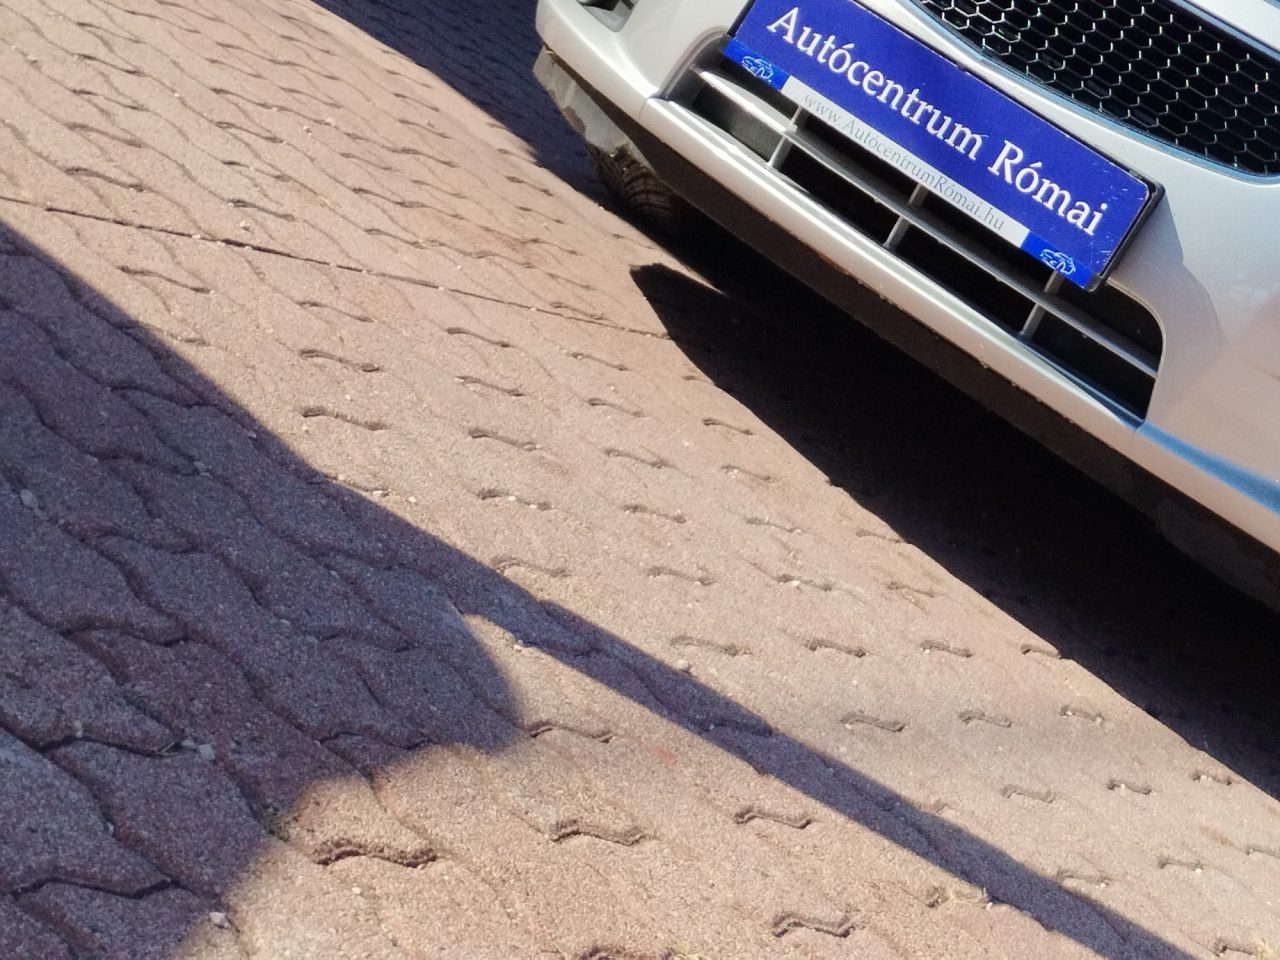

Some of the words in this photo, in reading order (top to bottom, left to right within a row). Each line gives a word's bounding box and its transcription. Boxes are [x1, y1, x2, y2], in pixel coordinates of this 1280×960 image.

[766, 6, 983, 161] Autócentrum
[988, 139, 1107, 236] Római
[803, 92, 1006, 231] www.AutócentrumRómai.hu
